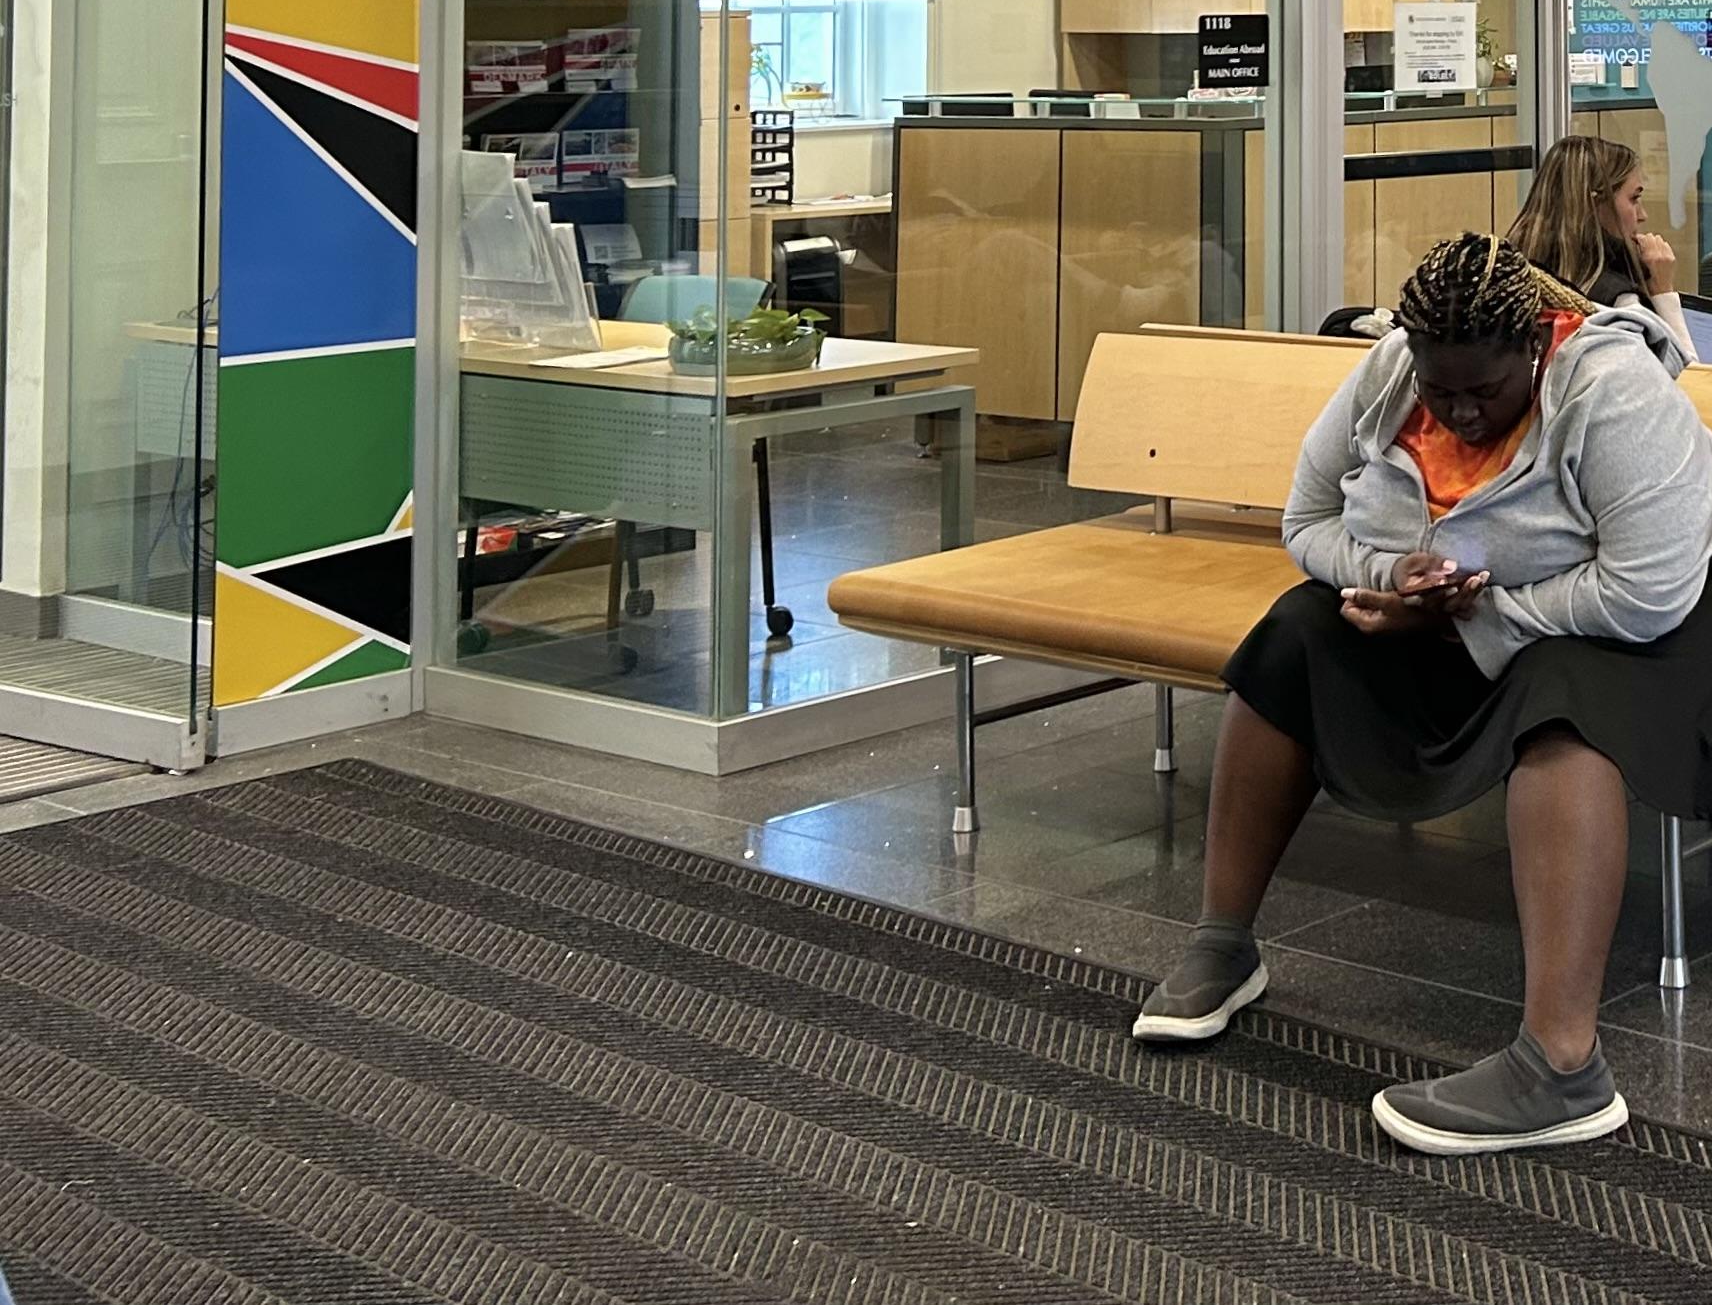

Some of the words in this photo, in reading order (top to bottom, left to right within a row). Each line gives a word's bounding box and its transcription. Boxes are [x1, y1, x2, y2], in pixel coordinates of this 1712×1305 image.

[1204, 17, 1232, 30] 1118
[1203, 44, 1239, 55] Education
[1239, 43, 1265, 54] Abroad
[1208, 68, 1231, 78] MAIN
[1231, 67, 1260, 78] OFFICE
